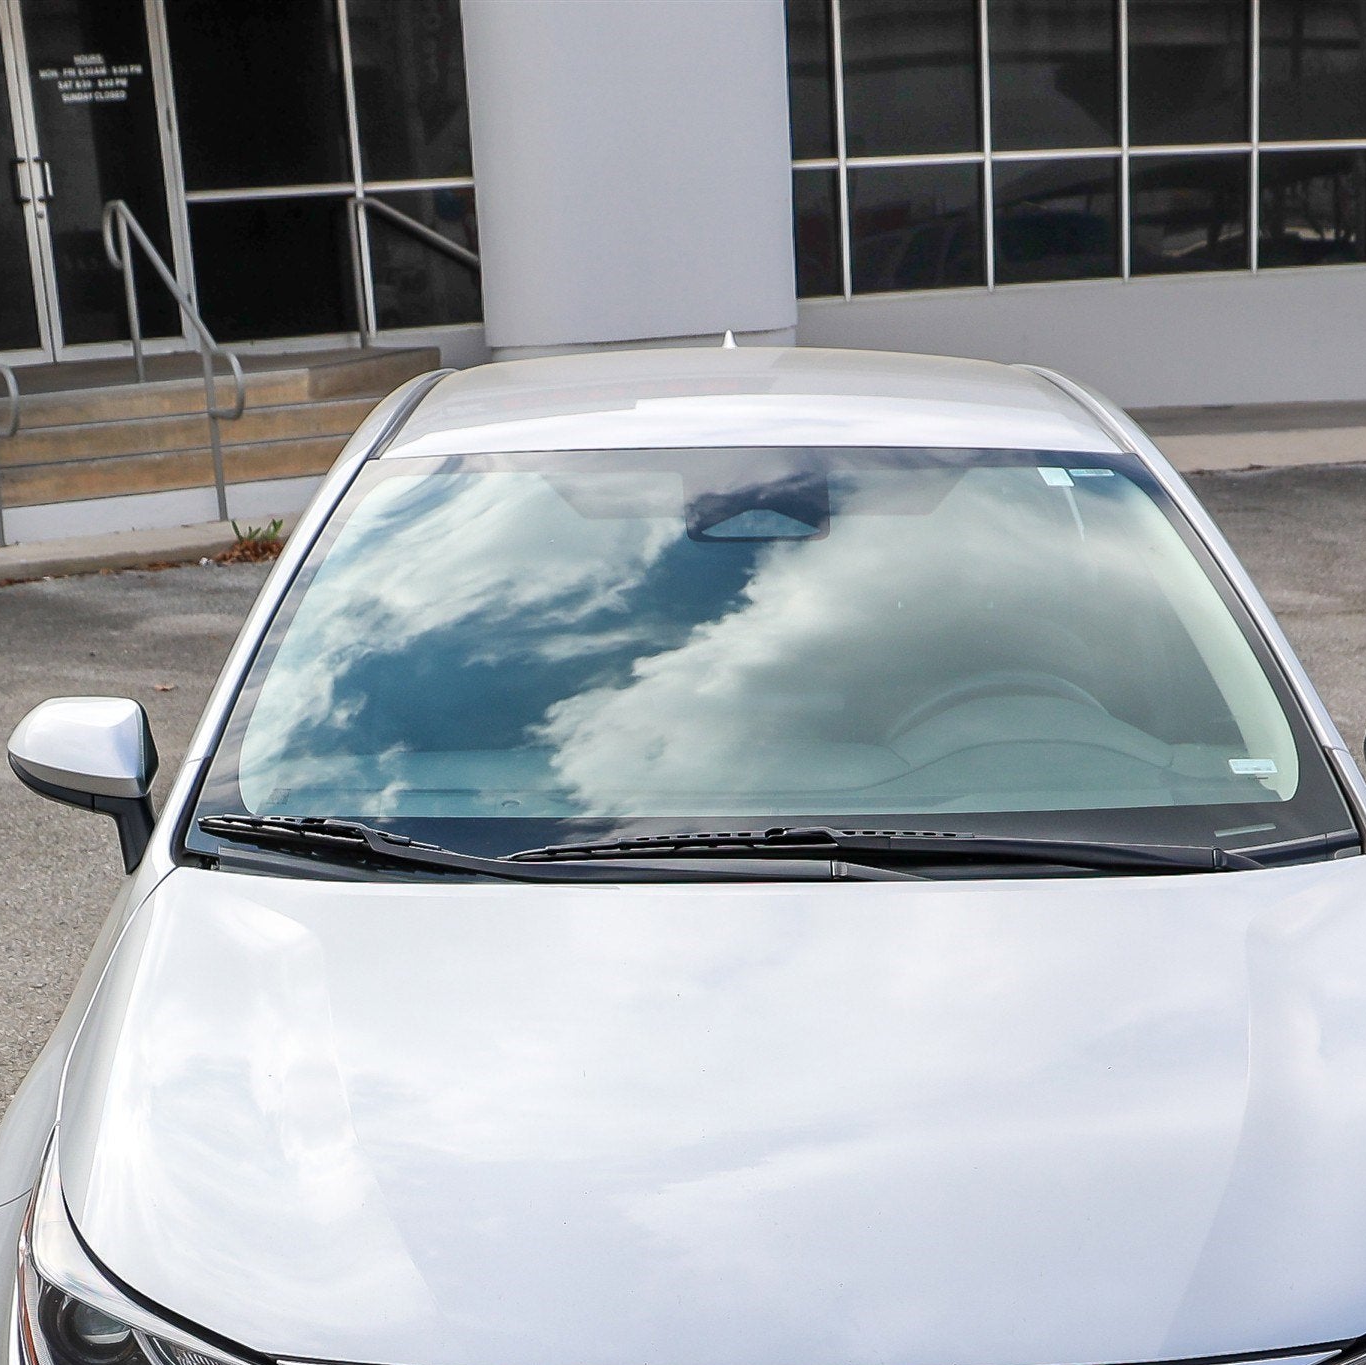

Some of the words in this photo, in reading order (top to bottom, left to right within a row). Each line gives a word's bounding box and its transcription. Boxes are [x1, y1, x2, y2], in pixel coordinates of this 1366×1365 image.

[57, 80, 72, 90] SAT
[62, 91, 93, 103] SUNDAY
[94, 90, 127, 102] CLOSED
